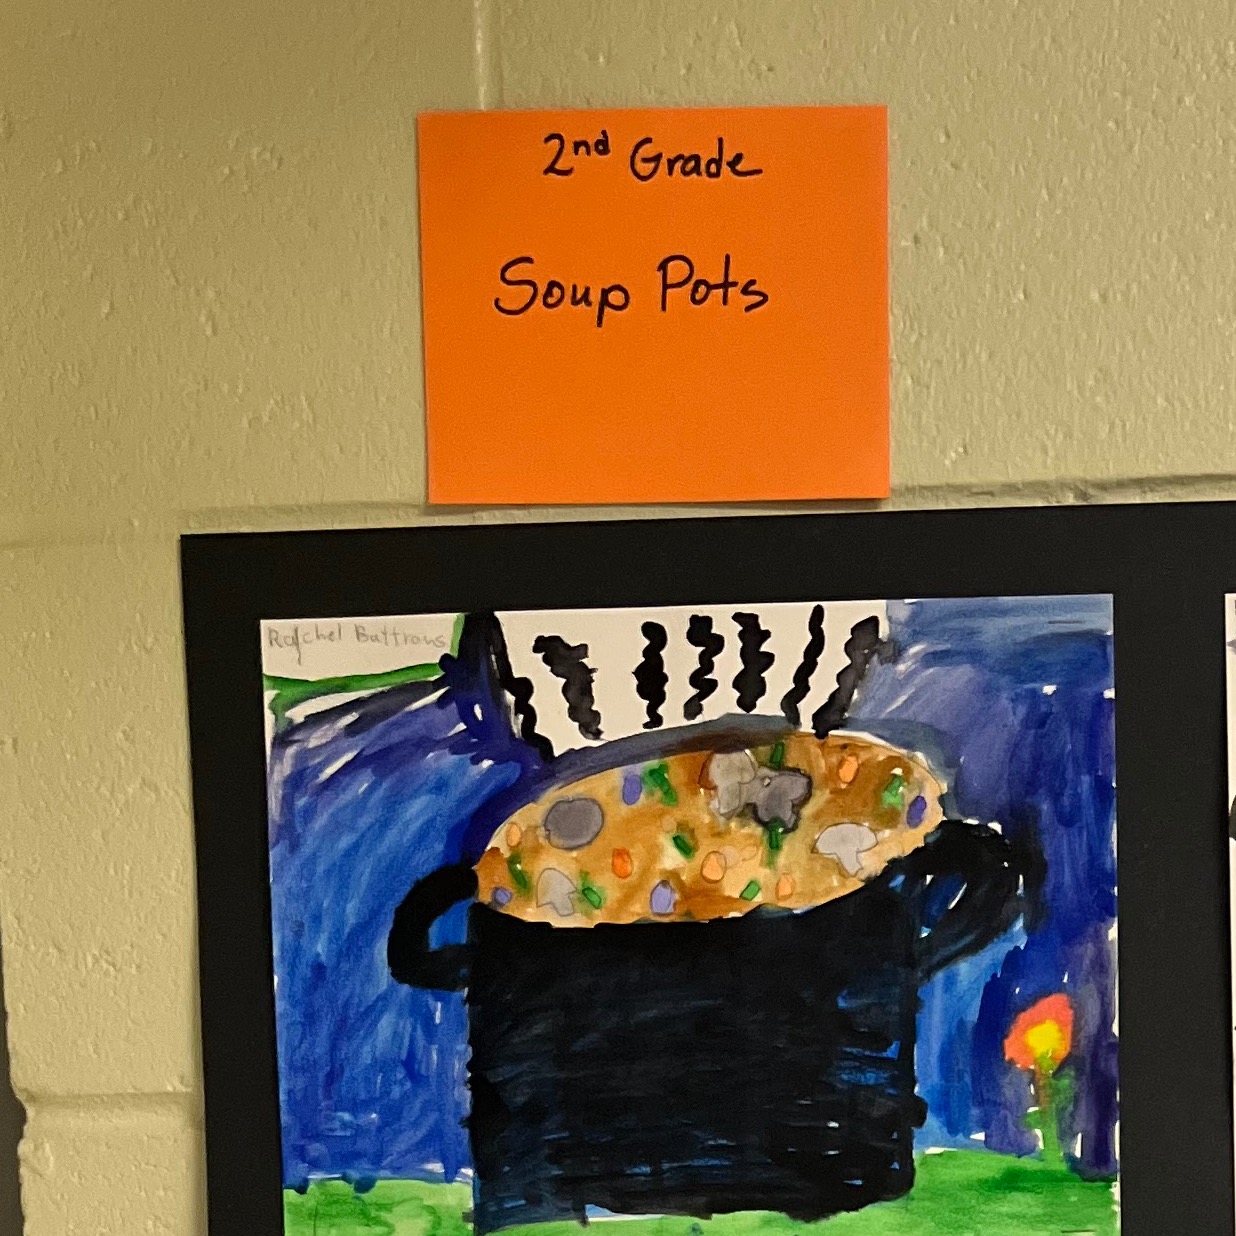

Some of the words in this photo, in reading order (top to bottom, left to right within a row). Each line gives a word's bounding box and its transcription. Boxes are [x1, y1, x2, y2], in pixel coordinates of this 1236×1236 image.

[542, 129, 611, 177] 2nd
[629, 136, 764, 182] Grade
[493, 255, 631, 328] Soup
[656, 253, 769, 313] Pots
